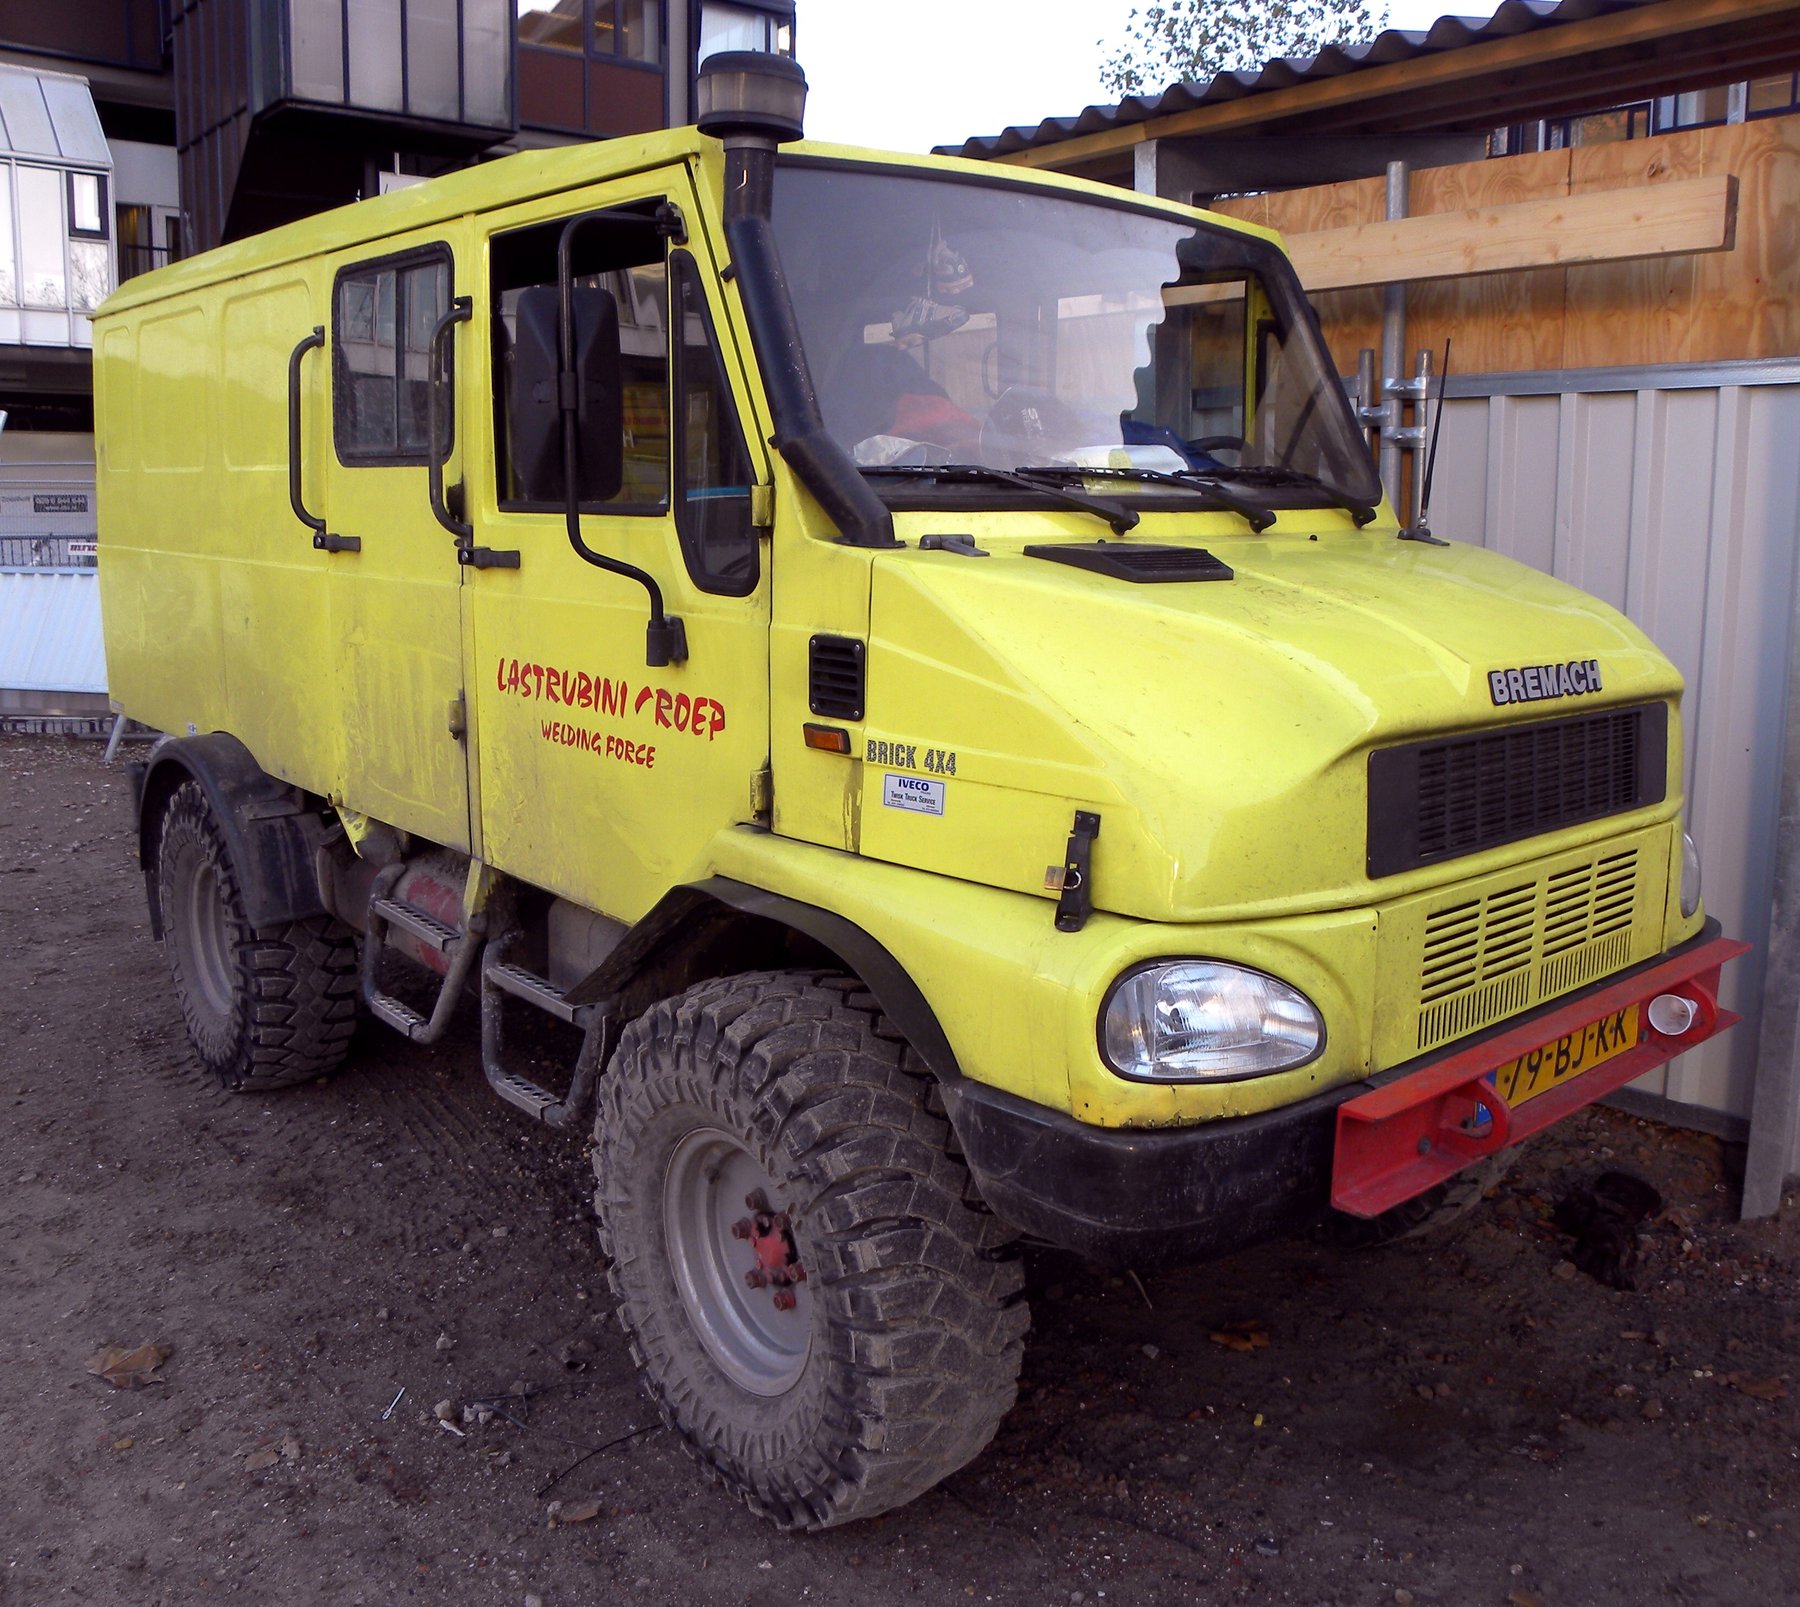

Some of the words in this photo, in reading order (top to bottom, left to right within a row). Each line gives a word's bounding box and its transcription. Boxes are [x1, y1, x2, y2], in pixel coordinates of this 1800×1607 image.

[497, 658, 627, 718] LASTRUBINI
[1488, 660, 1602, 706] BREMACH
[541, 720, 601, 756] WELDING
[606, 735, 656, 768] FORCE
[866, 739, 916, 769] BRICK
[923, 749, 956, 776] 4X4
[898, 778, 930, 792] IVECO
